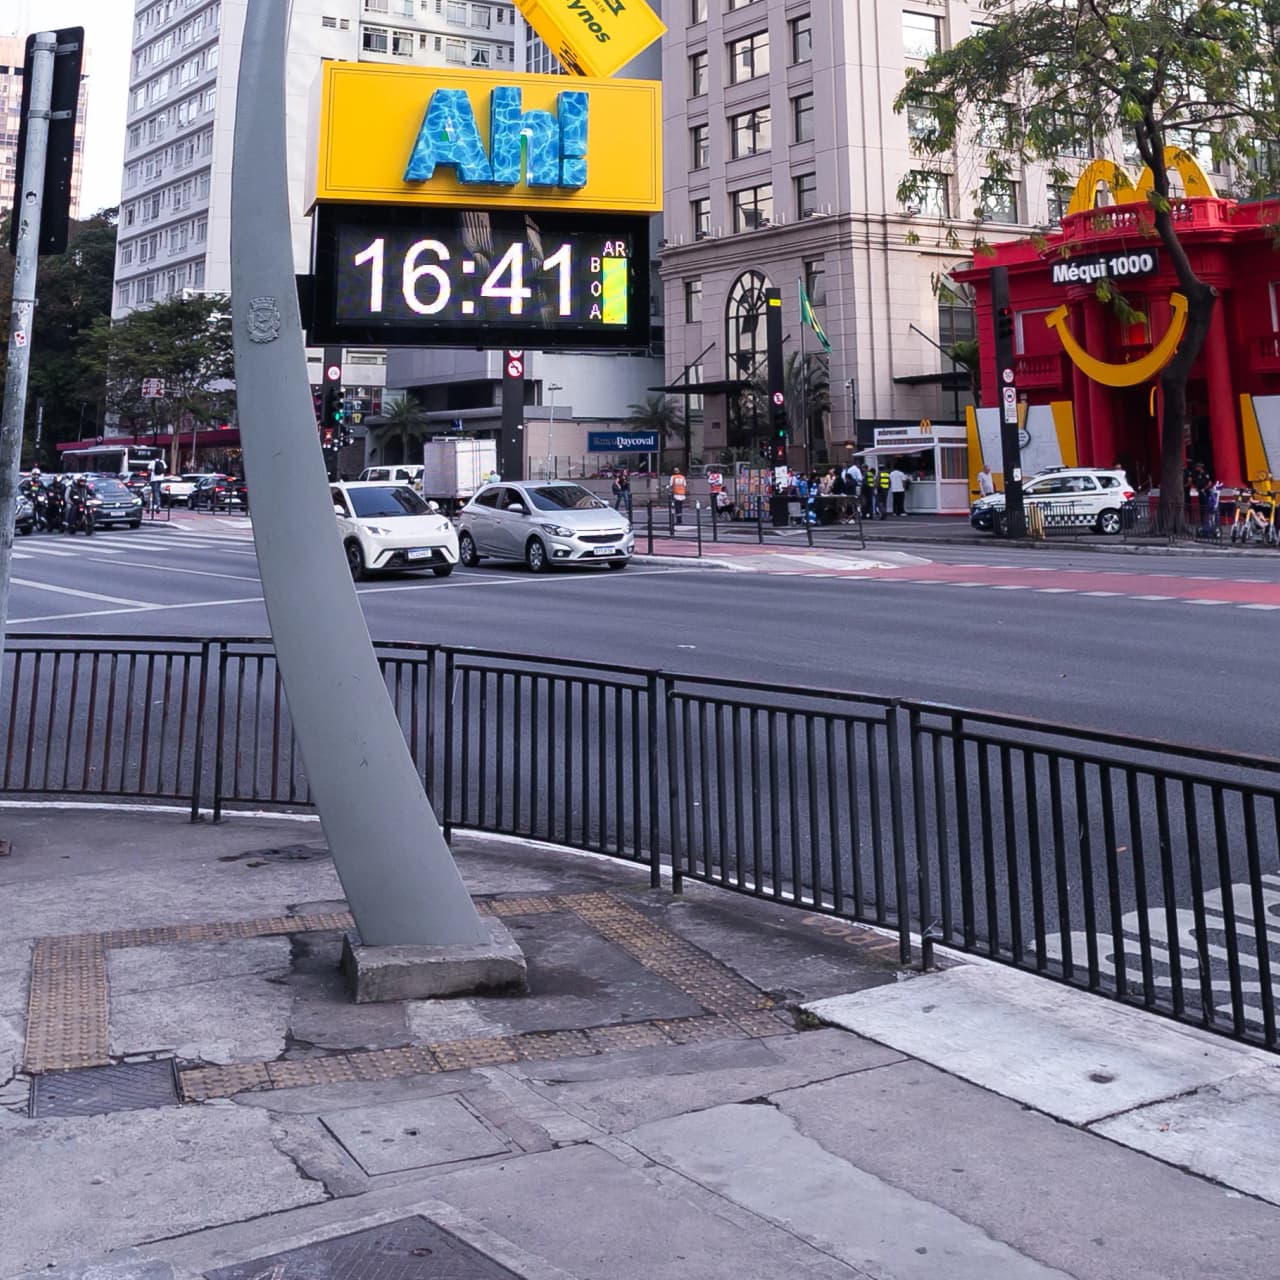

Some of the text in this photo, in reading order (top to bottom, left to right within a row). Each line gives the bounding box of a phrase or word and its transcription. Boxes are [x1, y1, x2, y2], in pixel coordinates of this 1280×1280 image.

[403, 86, 589, 189] Ah!
[602, 241, 627, 257] AR
[354, 238, 572, 316] 16:41
[1053, 254, 1153, 283] Méqui 1000
[617, 436, 654, 448] Daycoval
